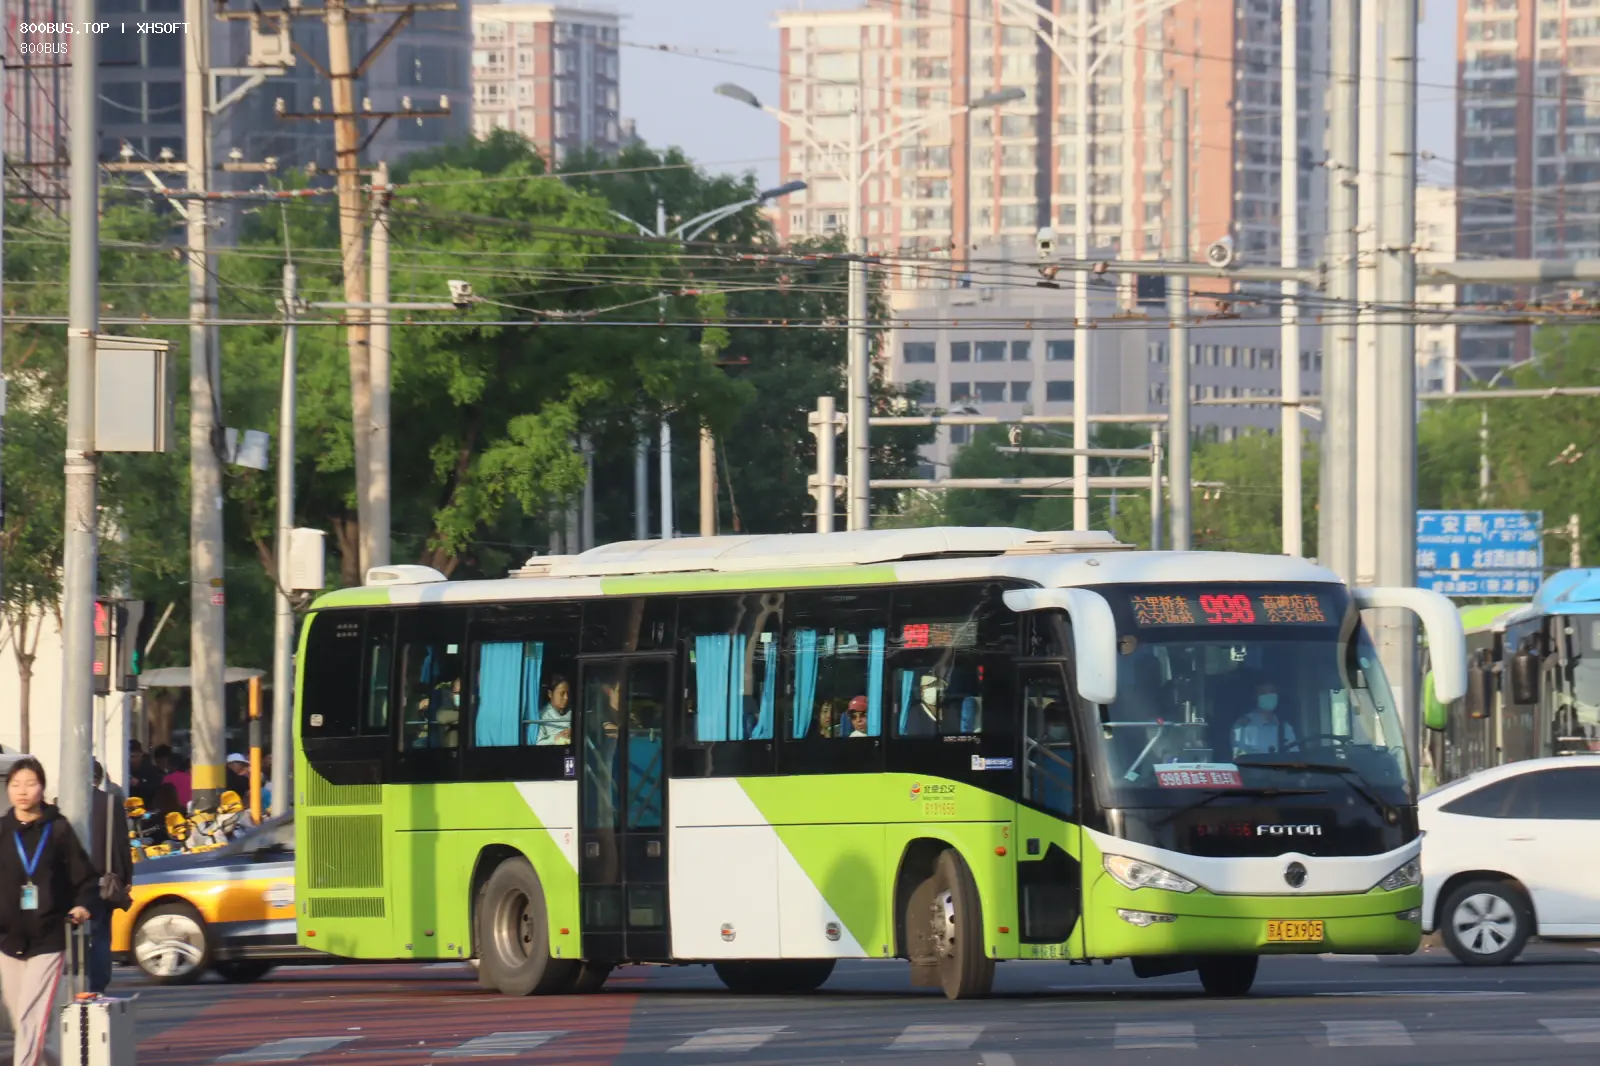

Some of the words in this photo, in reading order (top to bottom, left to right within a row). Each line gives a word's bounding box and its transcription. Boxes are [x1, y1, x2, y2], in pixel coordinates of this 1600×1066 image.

[1199, 594, 1256, 624] 998
[924, 784, 956, 794] 北京公交
[1256, 824, 1322, 836] FOTON
